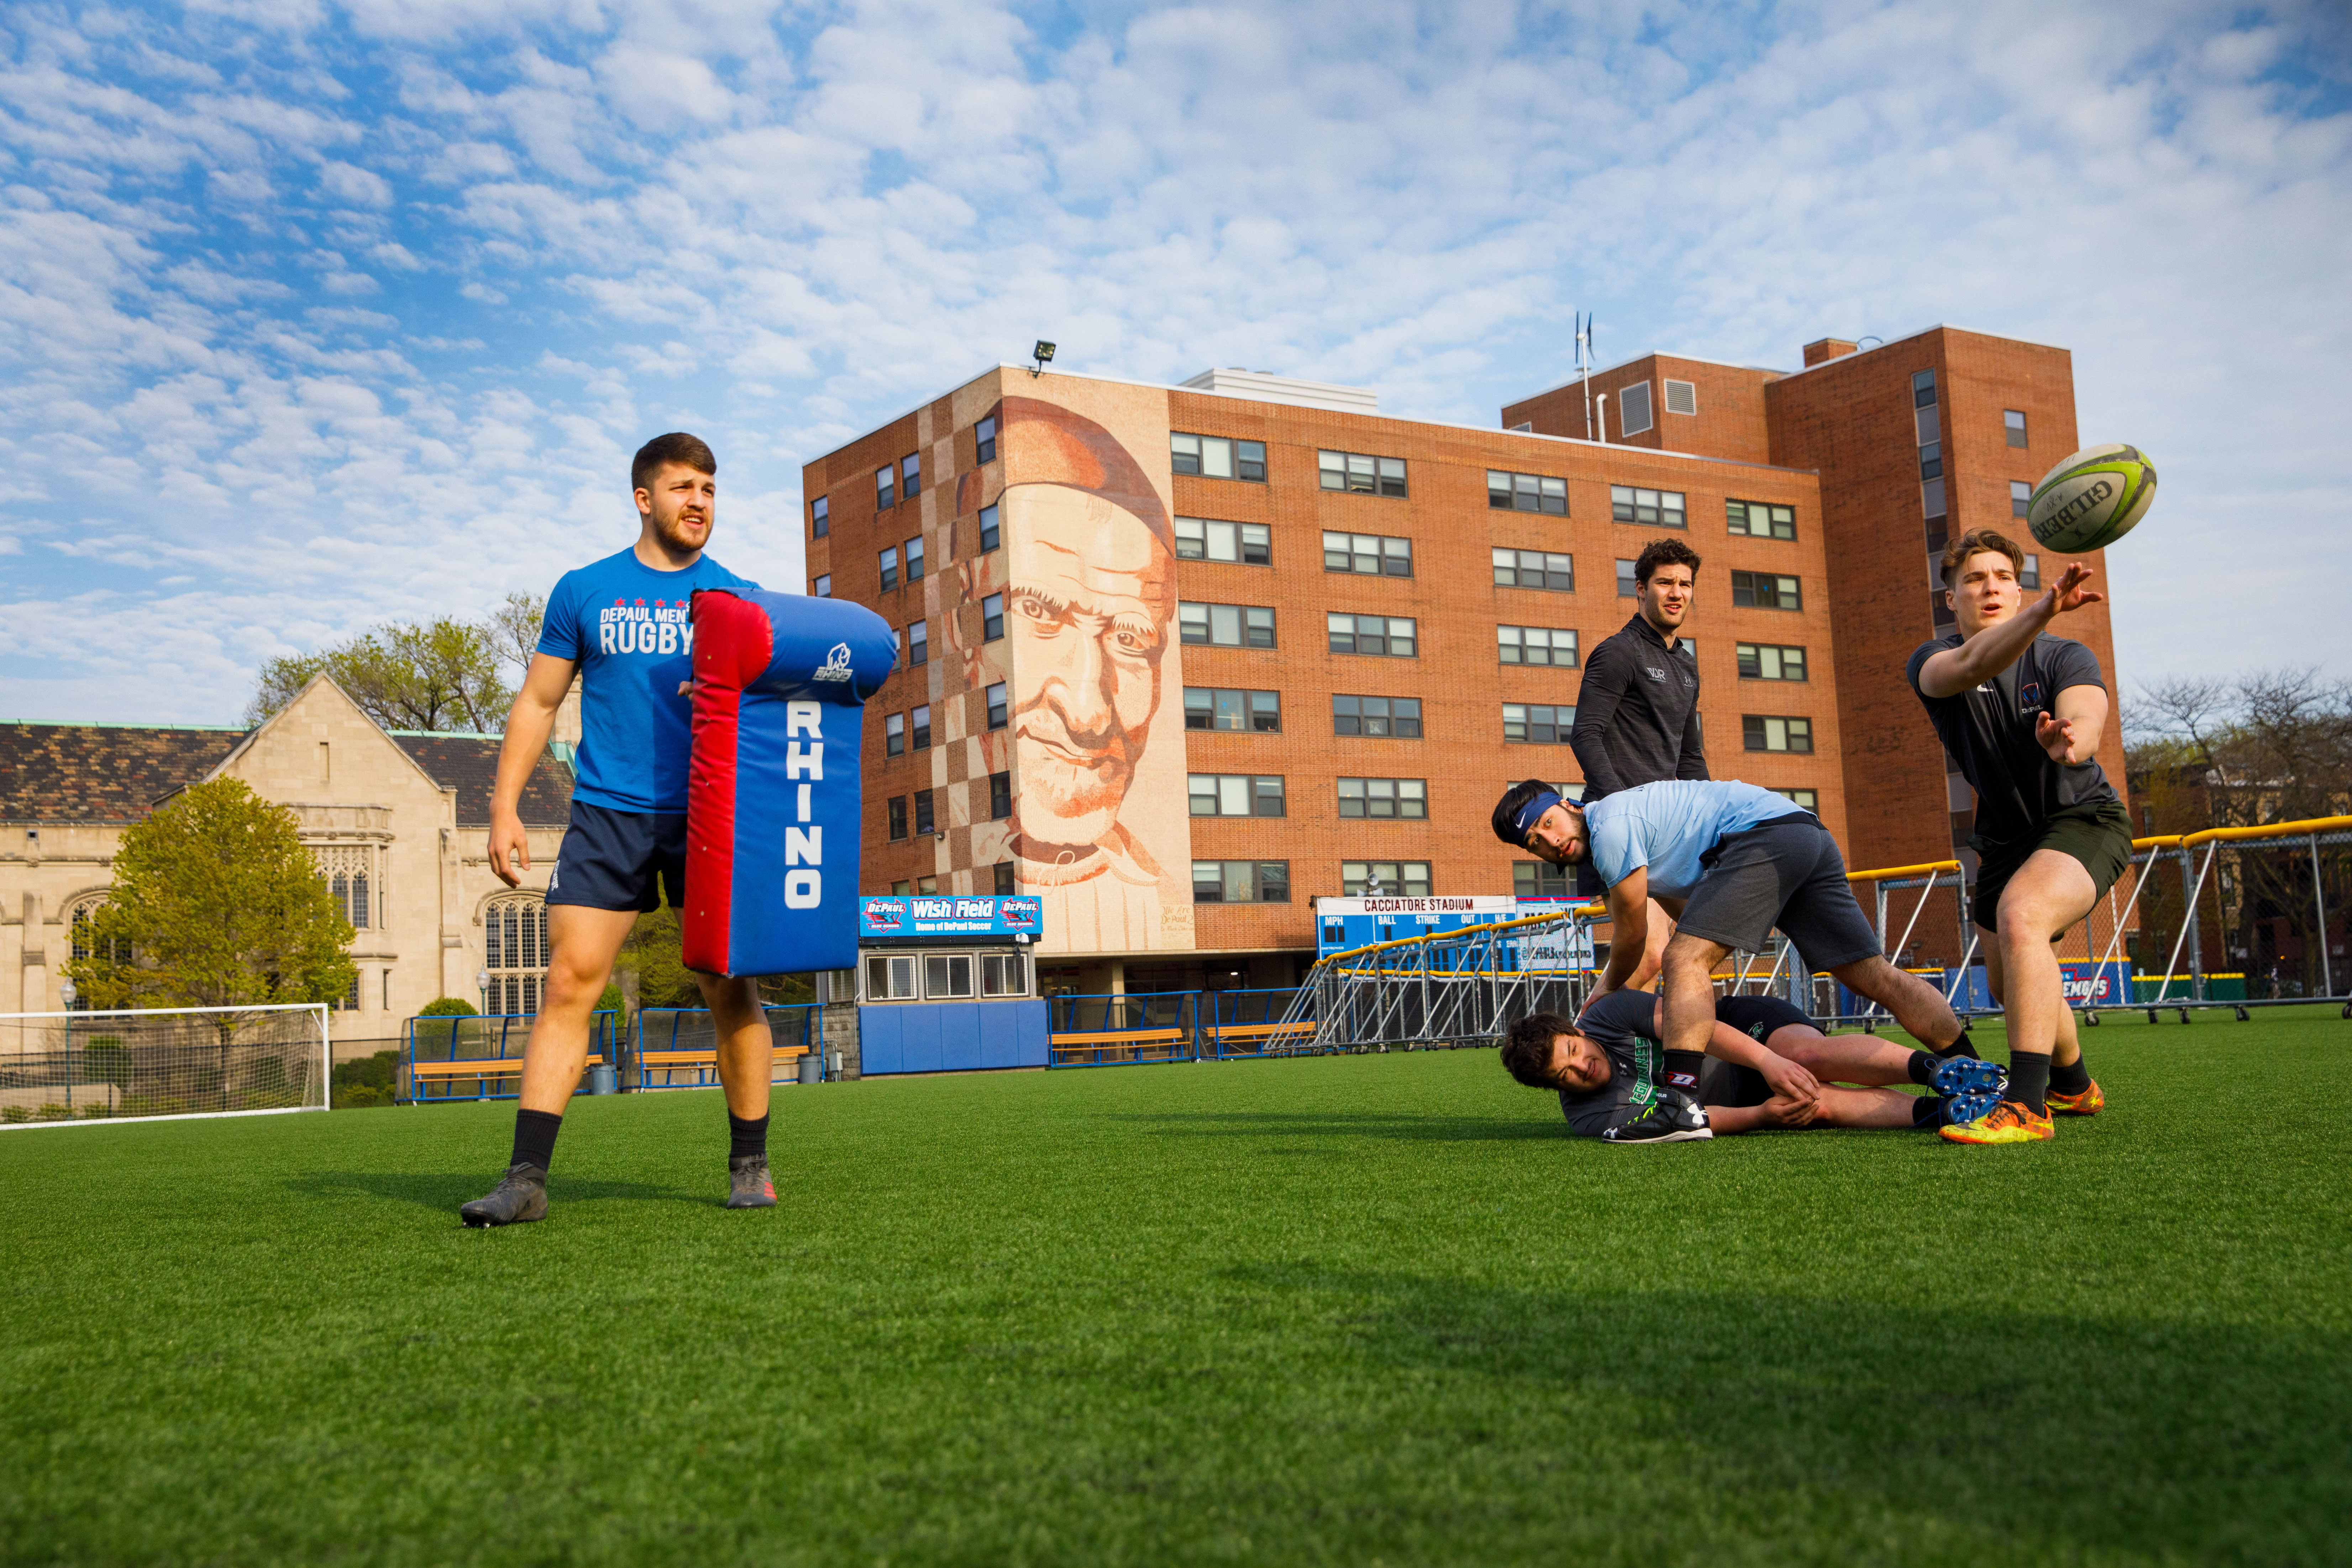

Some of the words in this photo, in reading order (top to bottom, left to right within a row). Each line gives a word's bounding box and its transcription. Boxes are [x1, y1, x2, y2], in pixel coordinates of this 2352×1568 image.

[2031, 481, 2112, 544] GILBERT
[600, 607, 652, 623] DEPAUL
[655, 608, 689, 623] MEN'
[600, 622, 694, 655] RUGBY
[813, 669, 852, 680] RHINO
[784, 701, 824, 909] RHINO
[912, 900, 952, 918] Wish
[955, 899, 994, 918] Field
[1365, 899, 1426, 912] CACCIATORE
[1430, 898, 1473, 911] STADIUM
[1325, 916, 1343, 926] MPH
[1378, 916, 1396, 925] BALL
[1416, 915, 1440, 924] STRIKE
[1461, 914, 1475, 923] OUT
[1495, 914, 1506, 923] H/E
[915, 922, 935, 931] Home
[936, 922, 943, 931] of
[944, 922, 967, 931] DePaul
[968, 921, 992, 930] Soccer
